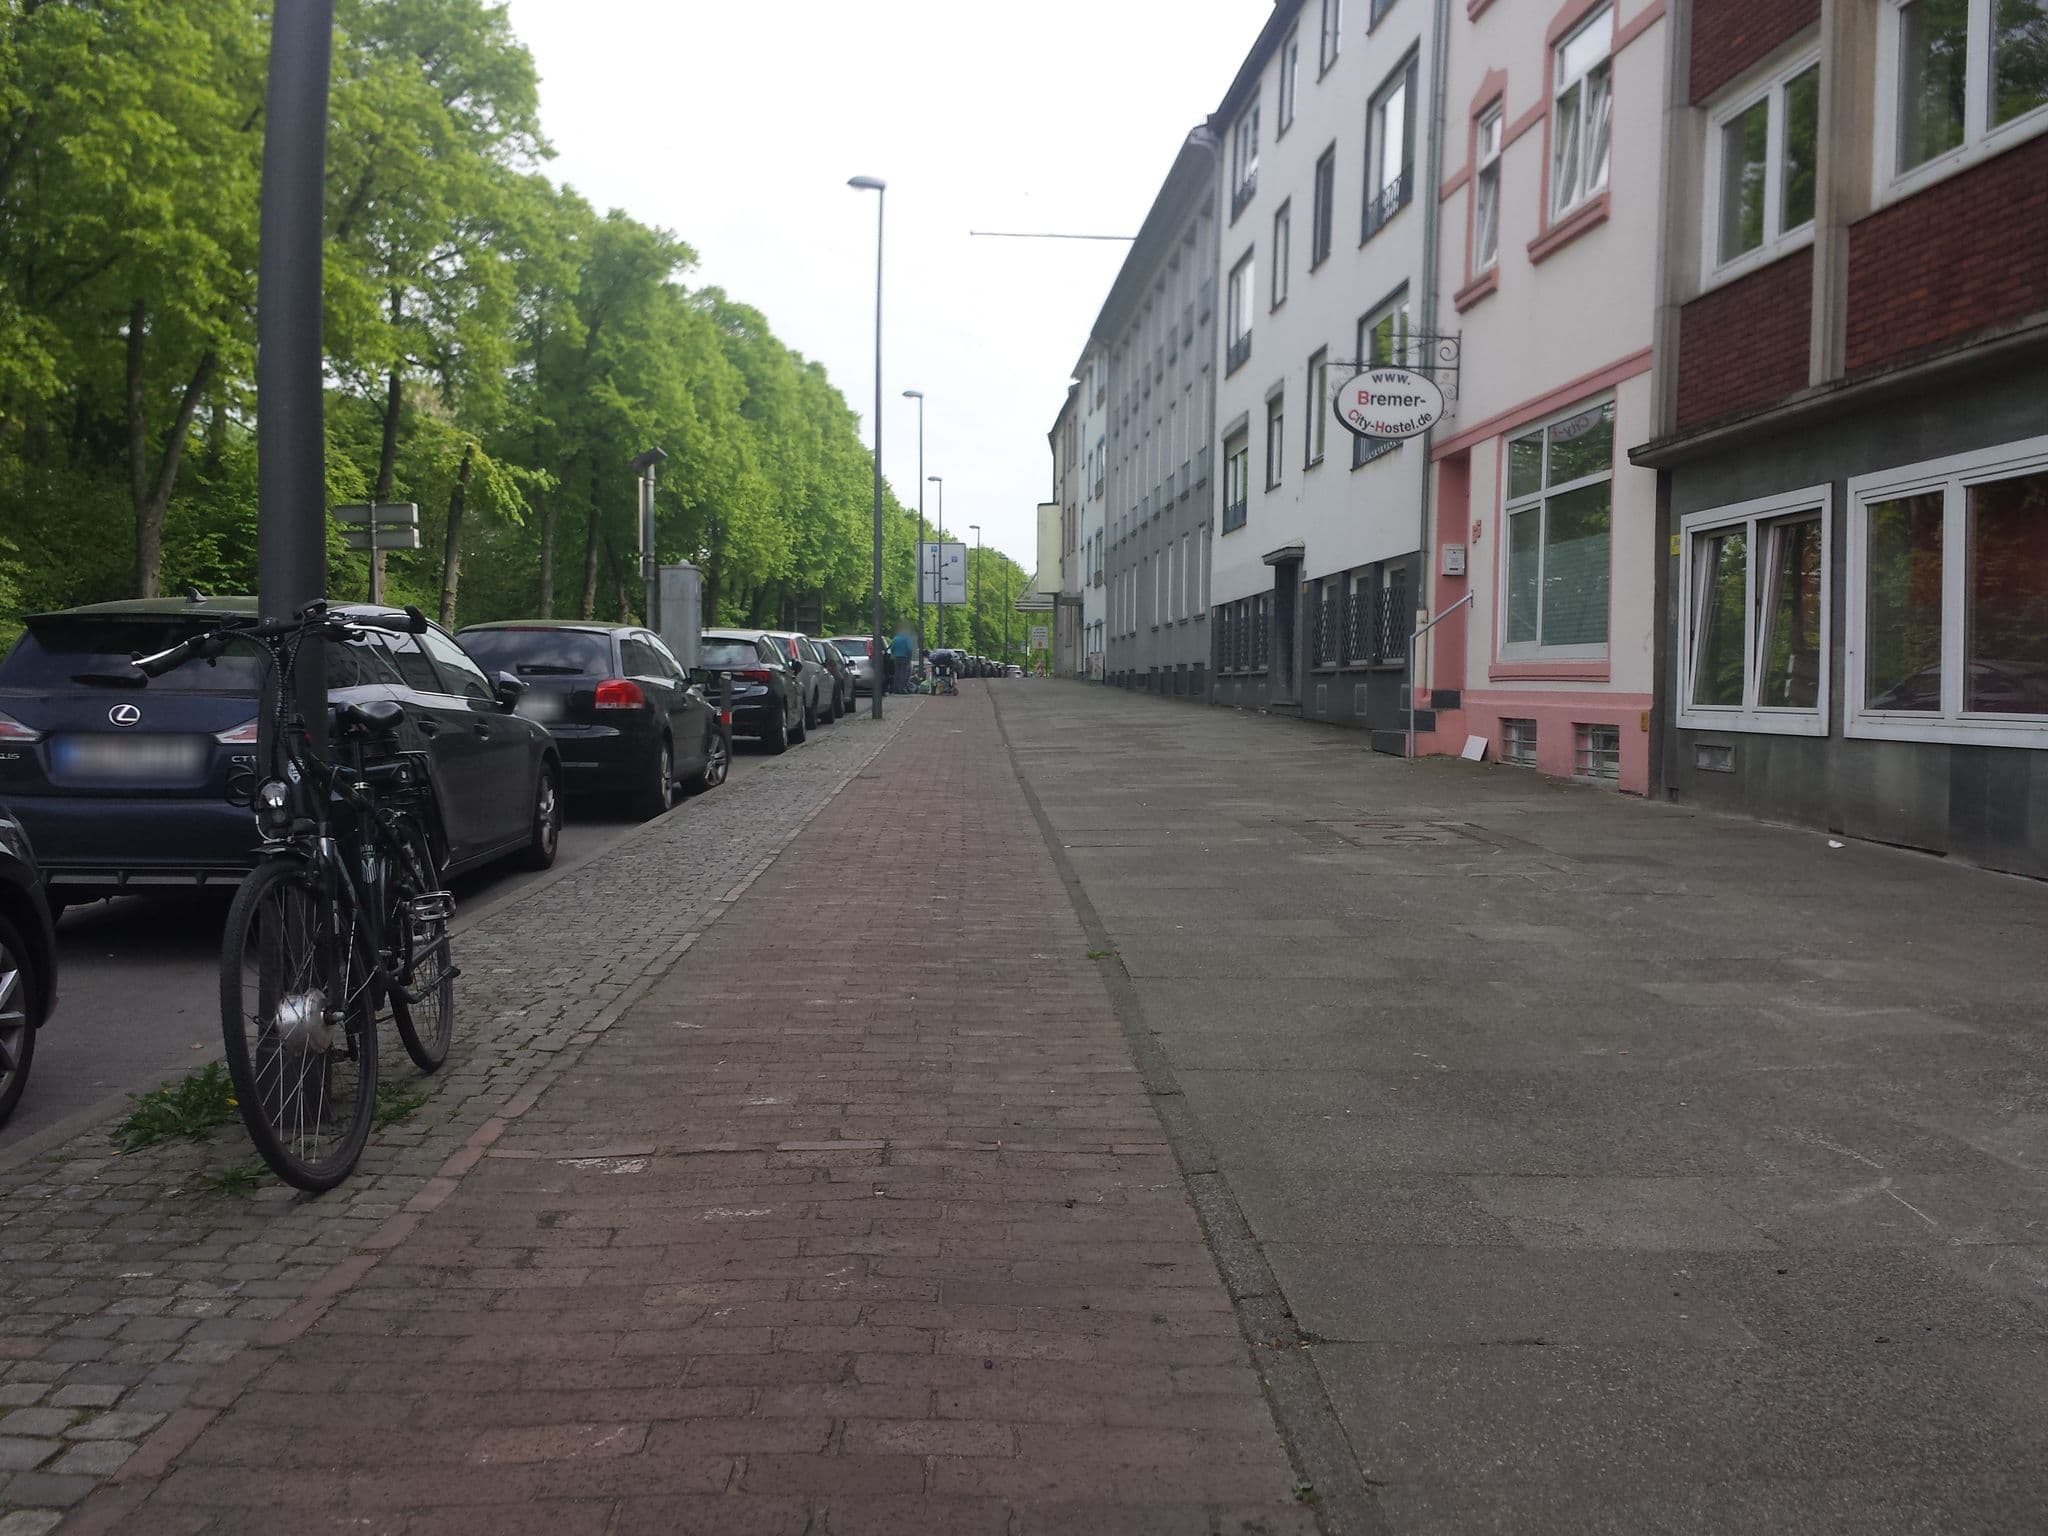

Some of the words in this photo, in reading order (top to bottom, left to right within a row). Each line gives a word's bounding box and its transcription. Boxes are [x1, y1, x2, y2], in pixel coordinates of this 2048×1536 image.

[1372, 374, 1411, 385] www.
[1358, 391, 1426, 407] Bremer-
[1348, 409, 1433, 433] City-Hostel.de
